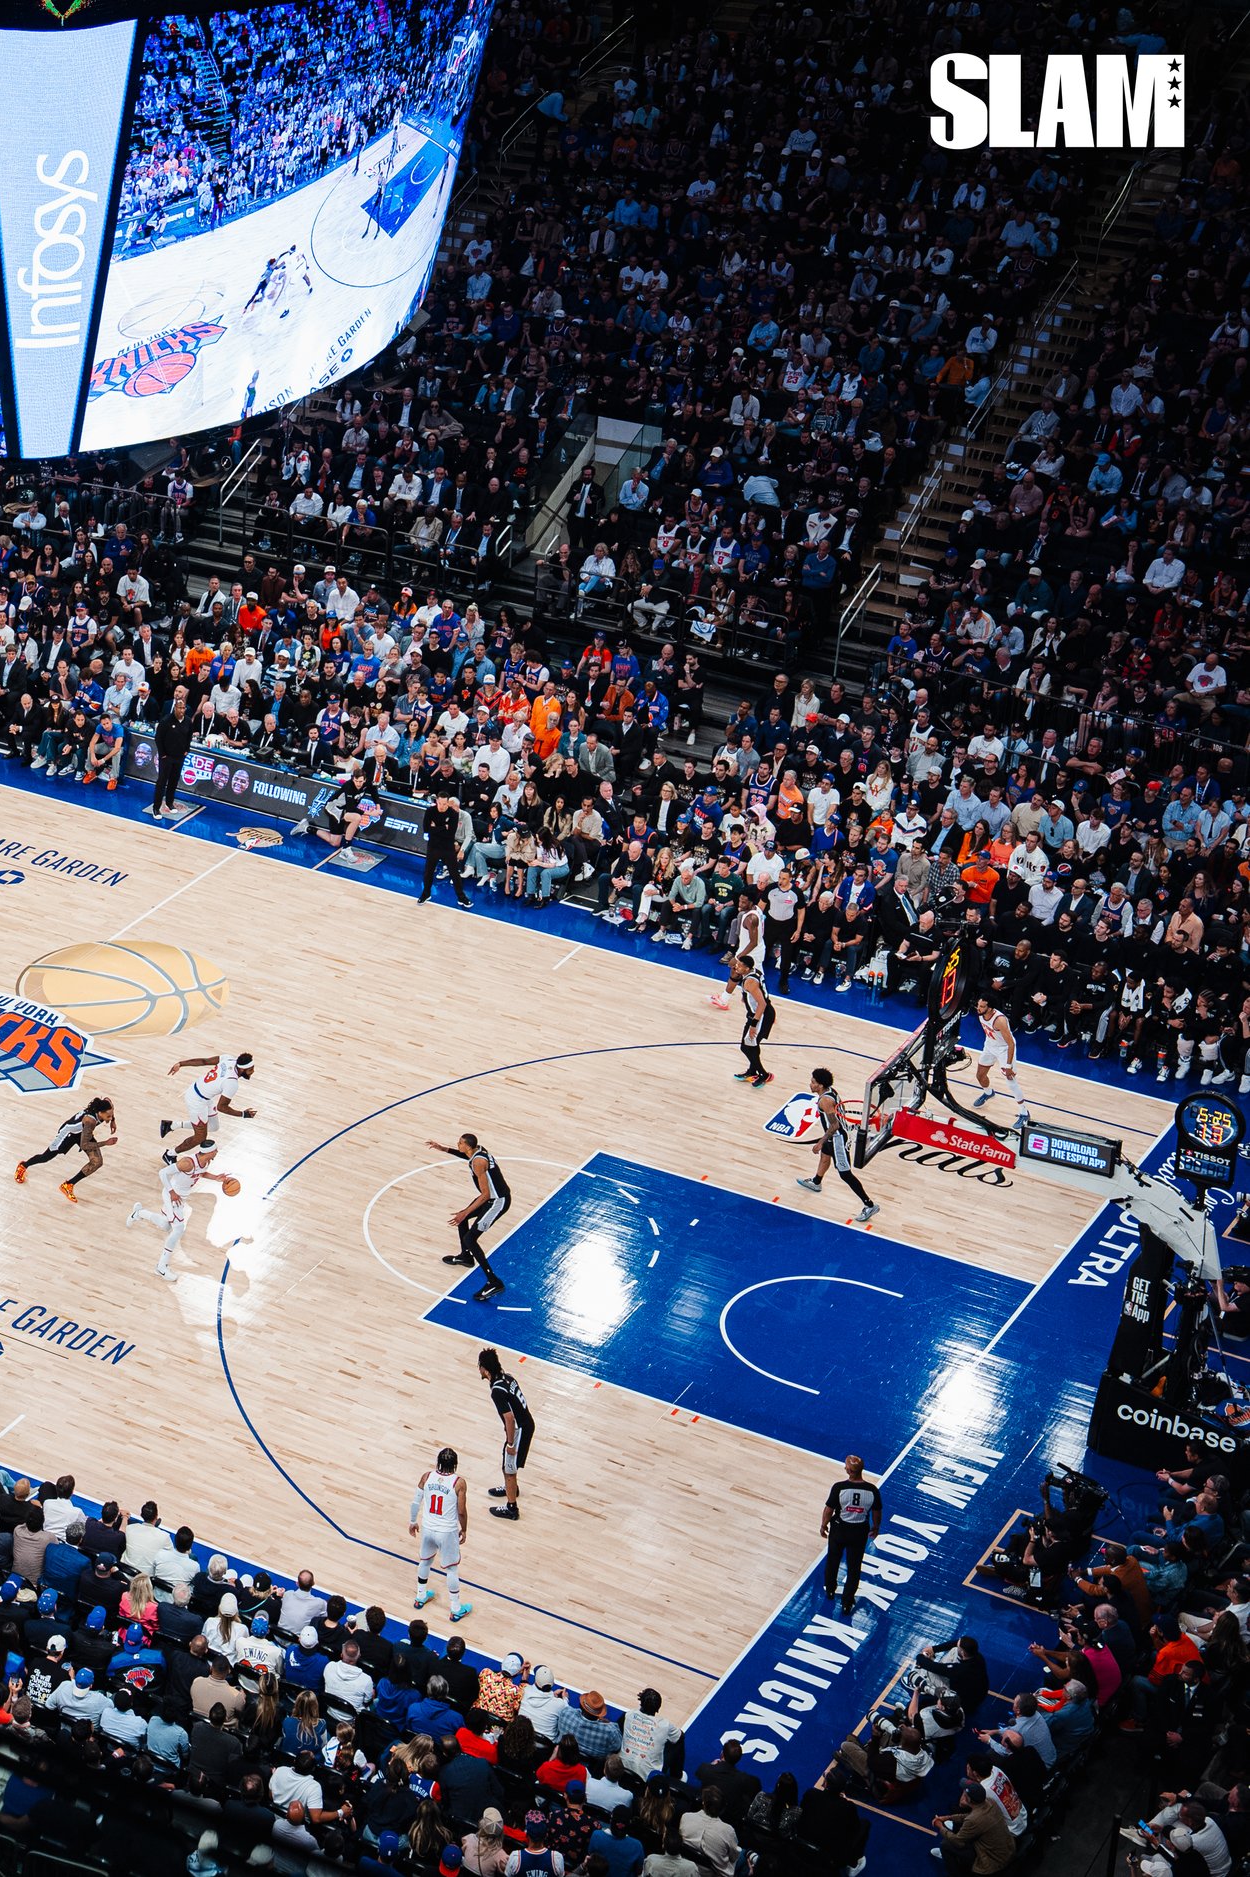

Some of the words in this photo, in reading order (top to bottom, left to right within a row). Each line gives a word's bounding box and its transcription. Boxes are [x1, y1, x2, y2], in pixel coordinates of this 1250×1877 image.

[15, 150, 98, 349] Infosys
[91, 321, 227, 388] KNICKS
[787, 376, 798, 384] 23
[252, 779, 307, 806] FOLLOWING
[383, 816, 419, 834] ESPN
[31, 850, 129, 887] GARDEN
[13, 998, 58, 1025] YORK
[769, 1121, 792, 1134] NBA
[1200, 1107, 1232, 1128] 5:25
[1051, 1138, 1098, 1157] DOWNLOAD
[1050, 1148, 1065, 1160] THE
[1066, 1151, 1089, 1166] ESPN
[1088, 1156, 1107, 1169] APP
[1195, 1151, 1231, 1166] TISSOT
[1131, 1288, 1150, 1302] THE
[1132, 1276, 1150, 1294] GET
[1131, 1302, 1150, 1324] App
[11, 1304, 136, 1365] GARDEN
[1117, 1402, 1237, 1453] coinbase
[428, 1482, 451, 1497] BRUNSON
[852, 1492, 860, 1506] 8
[430, 1494, 443, 1515] 11
[243, 1647, 268, 1663] EWING
[719, 1613, 868, 1763] KNICKS
